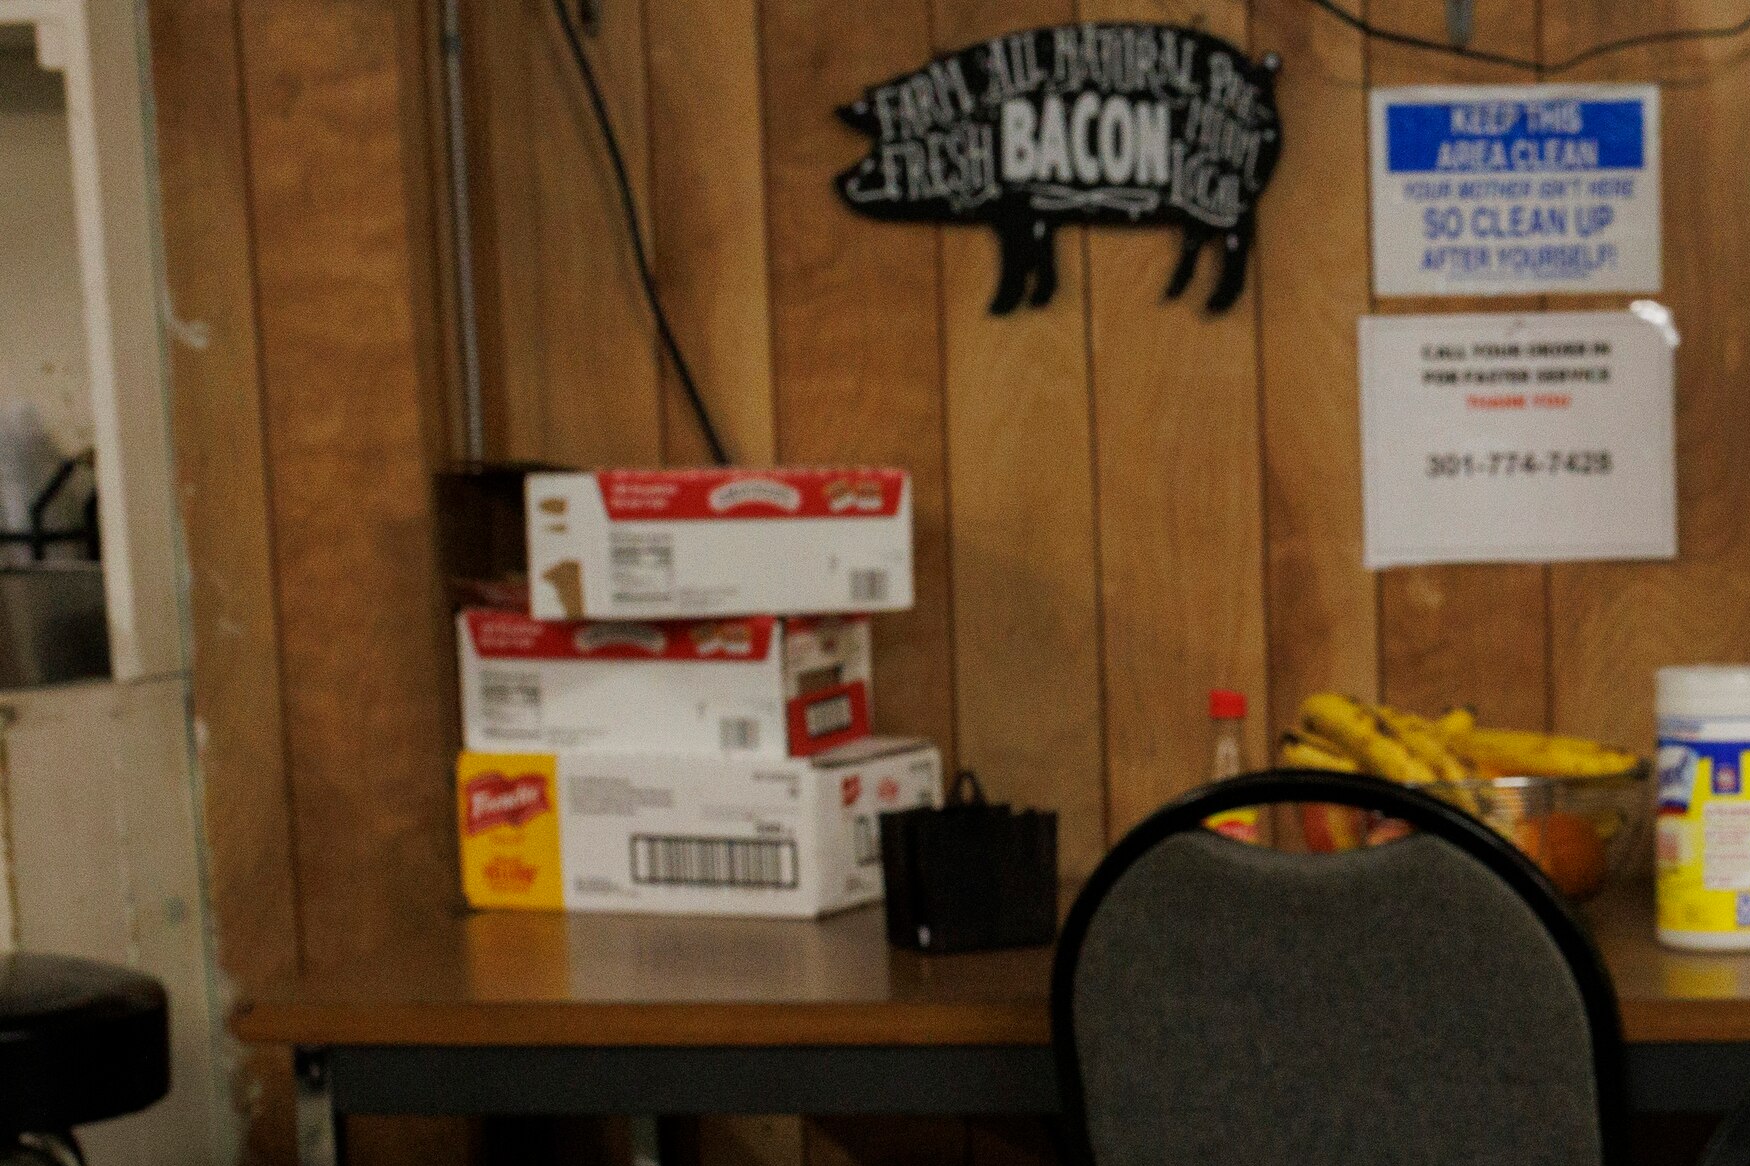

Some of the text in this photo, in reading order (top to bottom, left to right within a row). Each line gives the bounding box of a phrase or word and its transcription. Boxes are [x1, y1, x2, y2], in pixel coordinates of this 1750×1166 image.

[1052, 24, 1202, 95] NATURAL
[874, 58, 974, 142] FARM
[1451, 99, 1583, 133] KEEP THIS
[1001, 93, 1171, 185] BACON
[1436, 138, 1599, 168] AREA CLEAN
[880, 121, 996, 201] FRESH
[1458, 180, 1533, 198] MOTHER
[1422, 203, 1615, 240] SO CLEAN UP
[1419, 246, 1491, 272] AFTER
[1421, 340, 1612, 361] CALL YOUR ORDER IN
[1421, 369, 1458, 386] FOR
[1466, 394, 1526, 410] THANK
